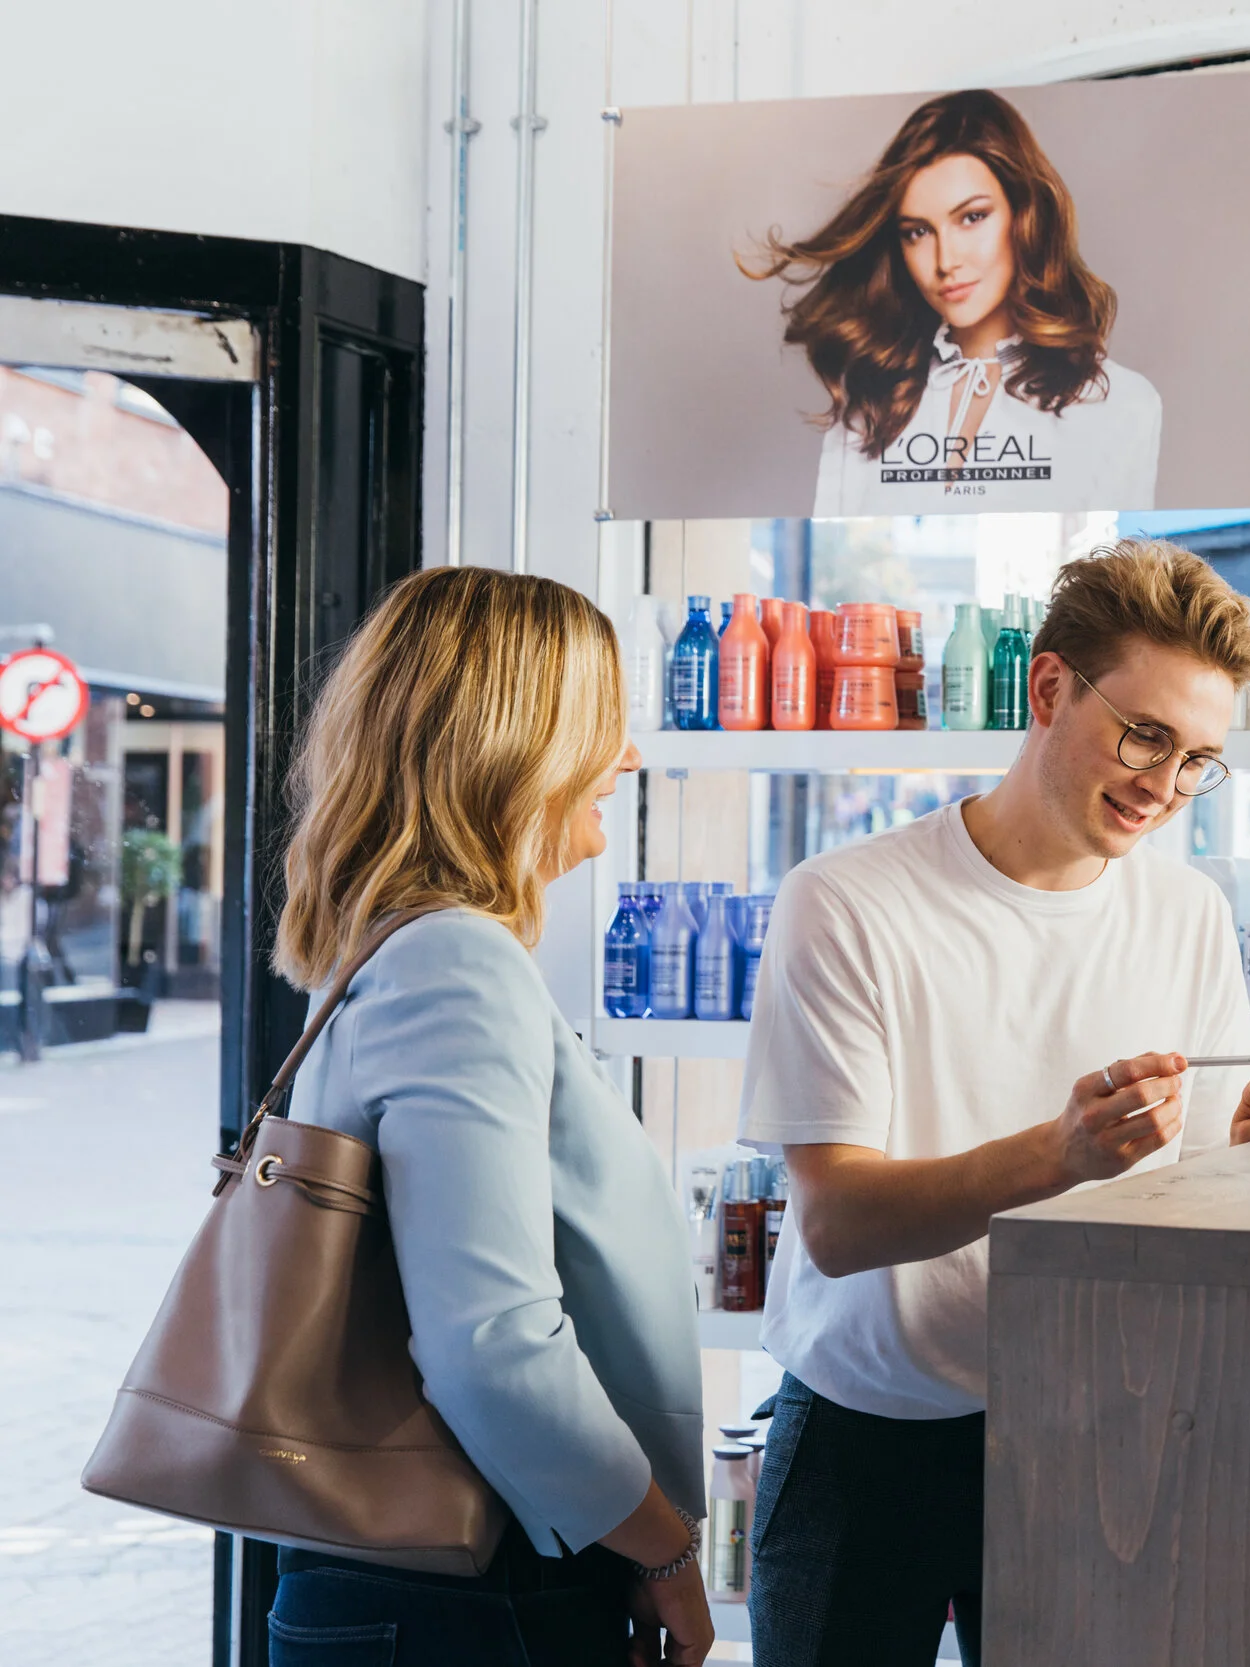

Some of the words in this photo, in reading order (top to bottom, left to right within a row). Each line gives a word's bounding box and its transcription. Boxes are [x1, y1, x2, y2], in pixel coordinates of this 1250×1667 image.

[881, 430, 1052, 465] L'ORÉAL
[882, 466, 1050, 482] PROFESSIONNEL
[944, 485, 987, 496] PARIS
